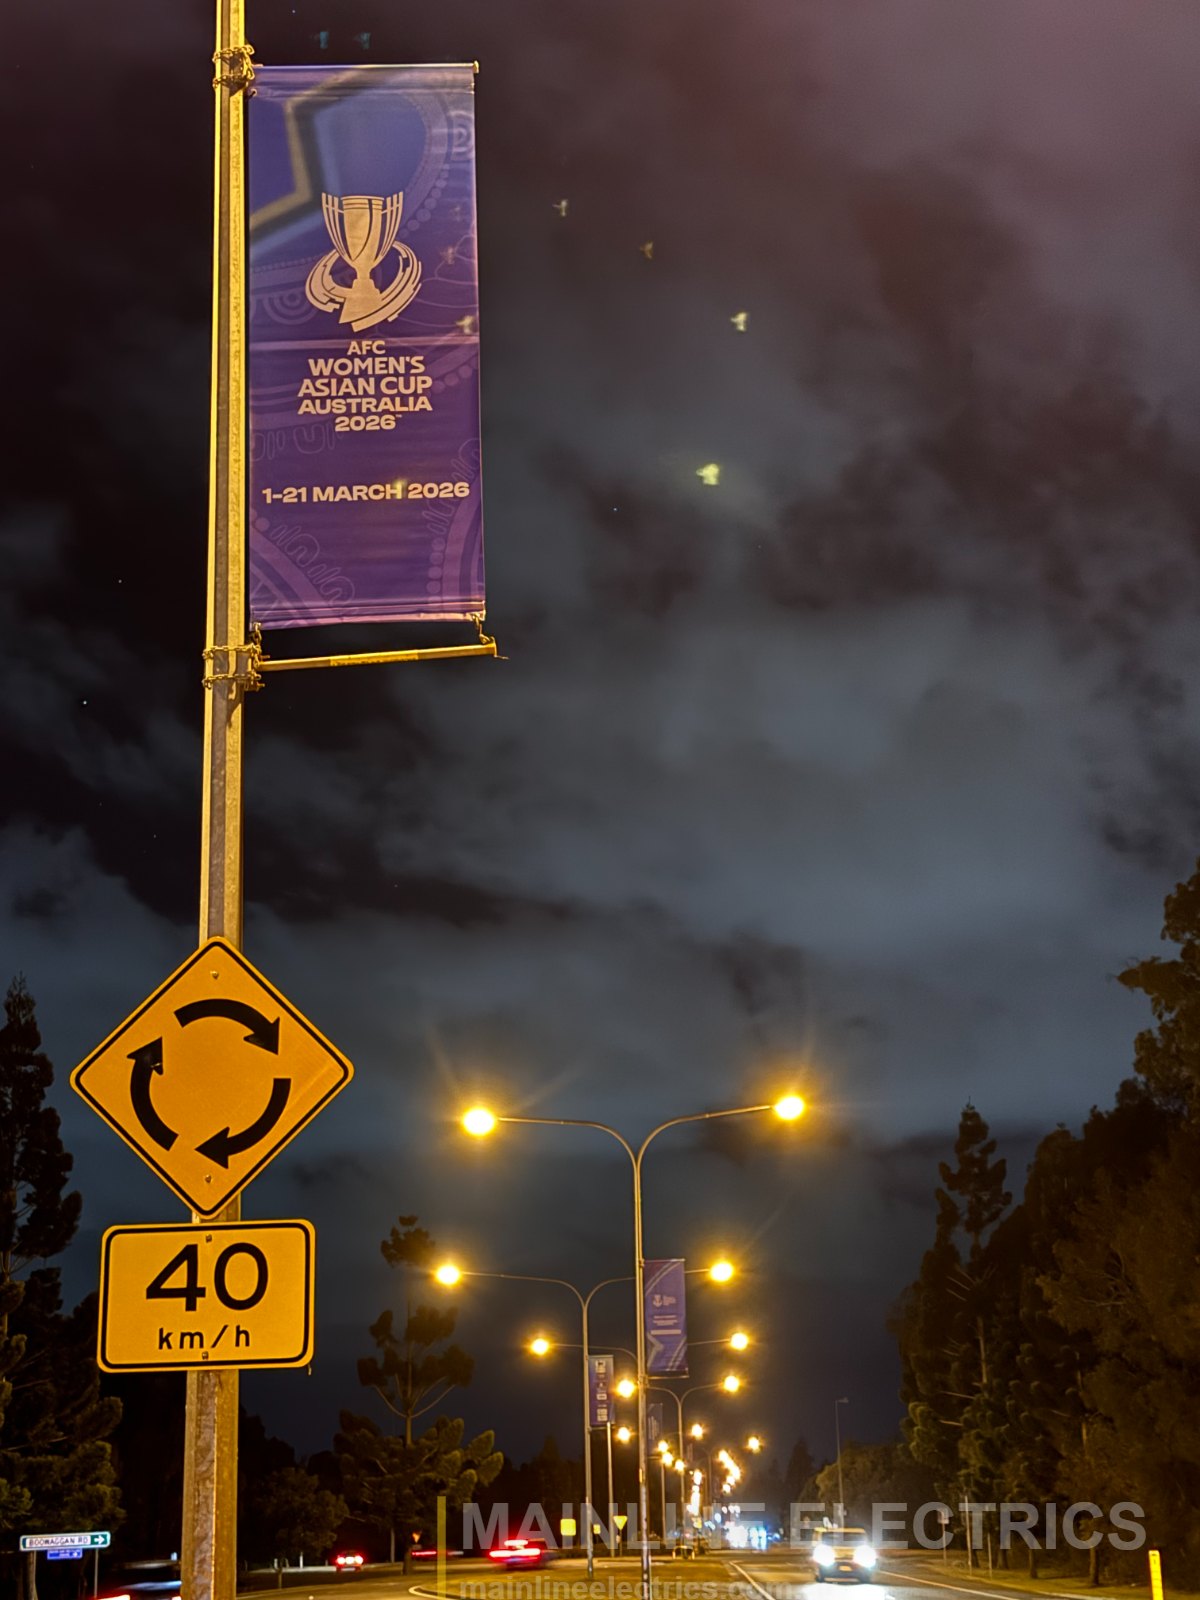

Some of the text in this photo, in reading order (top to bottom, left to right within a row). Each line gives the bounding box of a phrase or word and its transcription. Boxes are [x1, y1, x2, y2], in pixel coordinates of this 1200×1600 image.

[347, 340, 386, 355] AFC
[308, 356, 425, 376] WOMEN'S
[297, 375, 433, 397] ASIAN CUP
[297, 396, 433, 415] AUSTRALIA
[262, 482, 471, 504] 1-21 MARCH 2026
[146, 1242, 269, 1312] 40
[158, 1325, 250, 1350] km/h
[78, 1536, 89, 1544] RD
